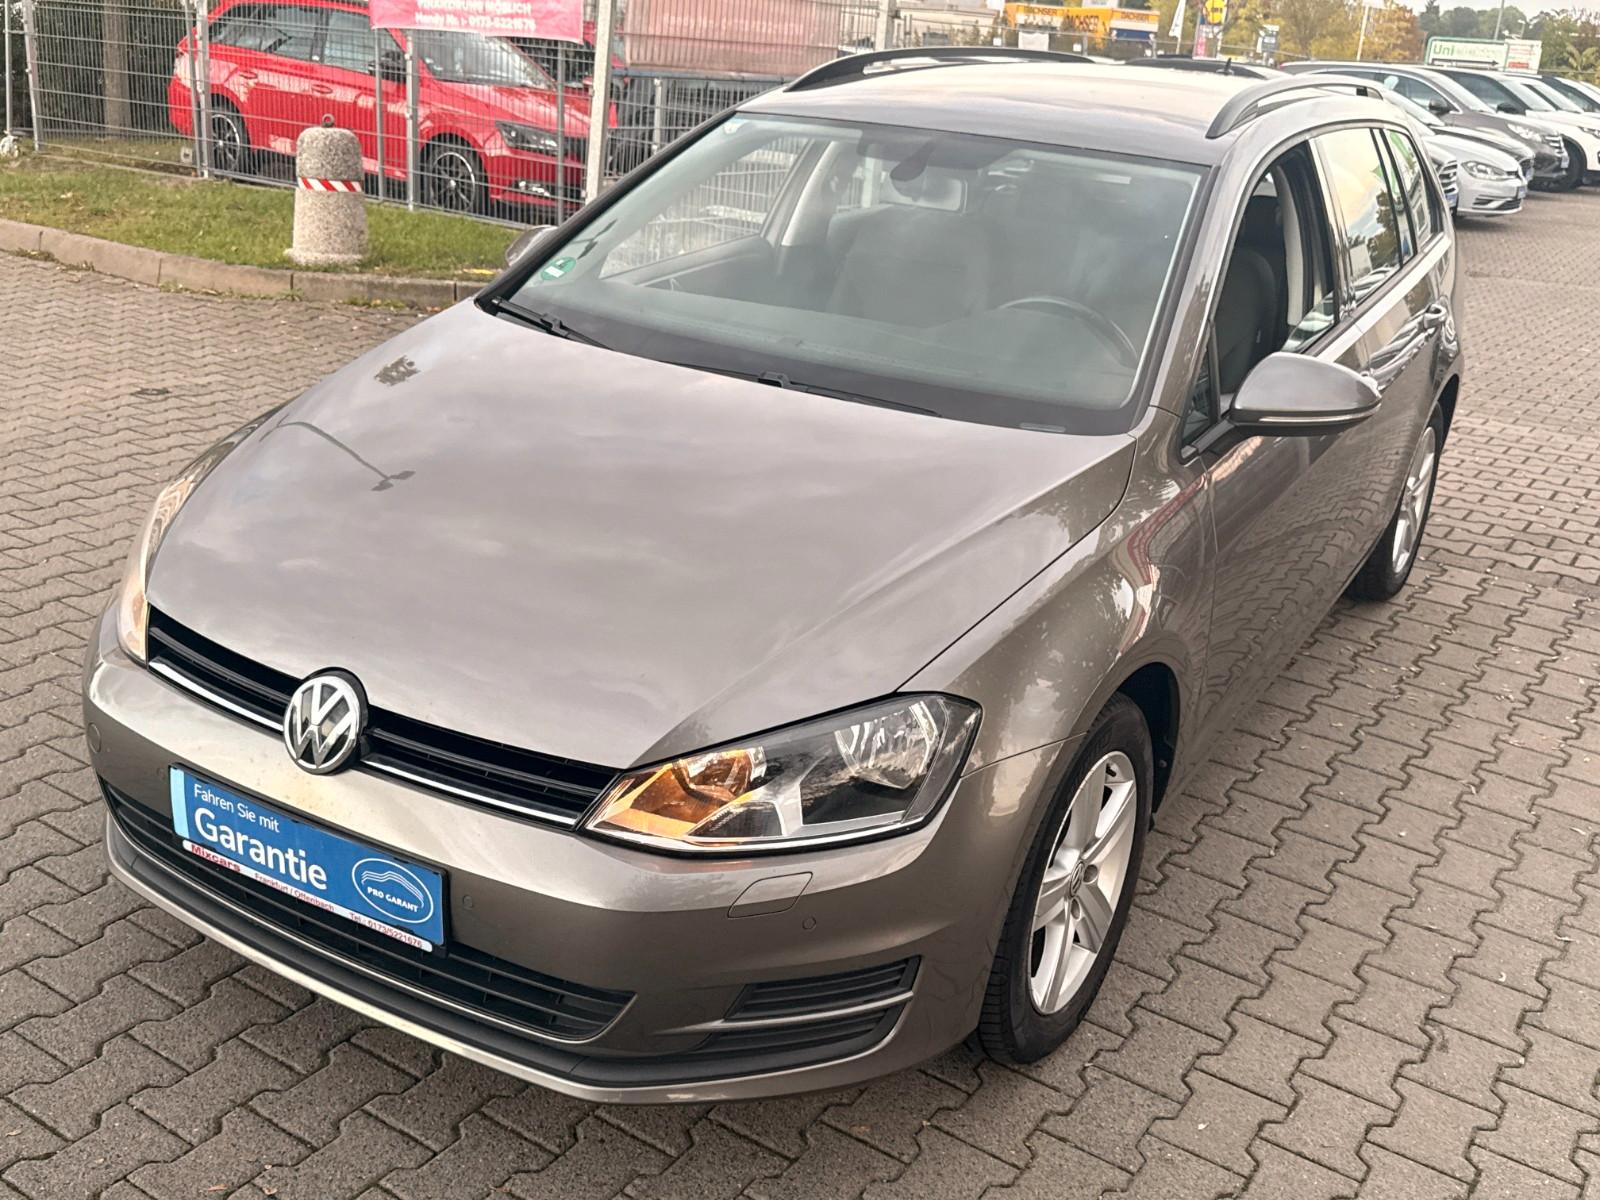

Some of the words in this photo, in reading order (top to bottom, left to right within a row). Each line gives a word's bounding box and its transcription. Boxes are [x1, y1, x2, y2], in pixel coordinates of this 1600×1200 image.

[194, 783, 234, 813] Fahren
[237, 802, 256, 823] Sie
[259, 815, 280, 833] mit
[190, 843, 241, 872] Mixcars
[194, 807, 328, 890] Garantie
[254, 872, 289, 893] Frankfurt
[294, 890, 335, 912] Offenbach
[367, 886, 384, 898] PRO
[385, 894, 418, 912] GARANT
